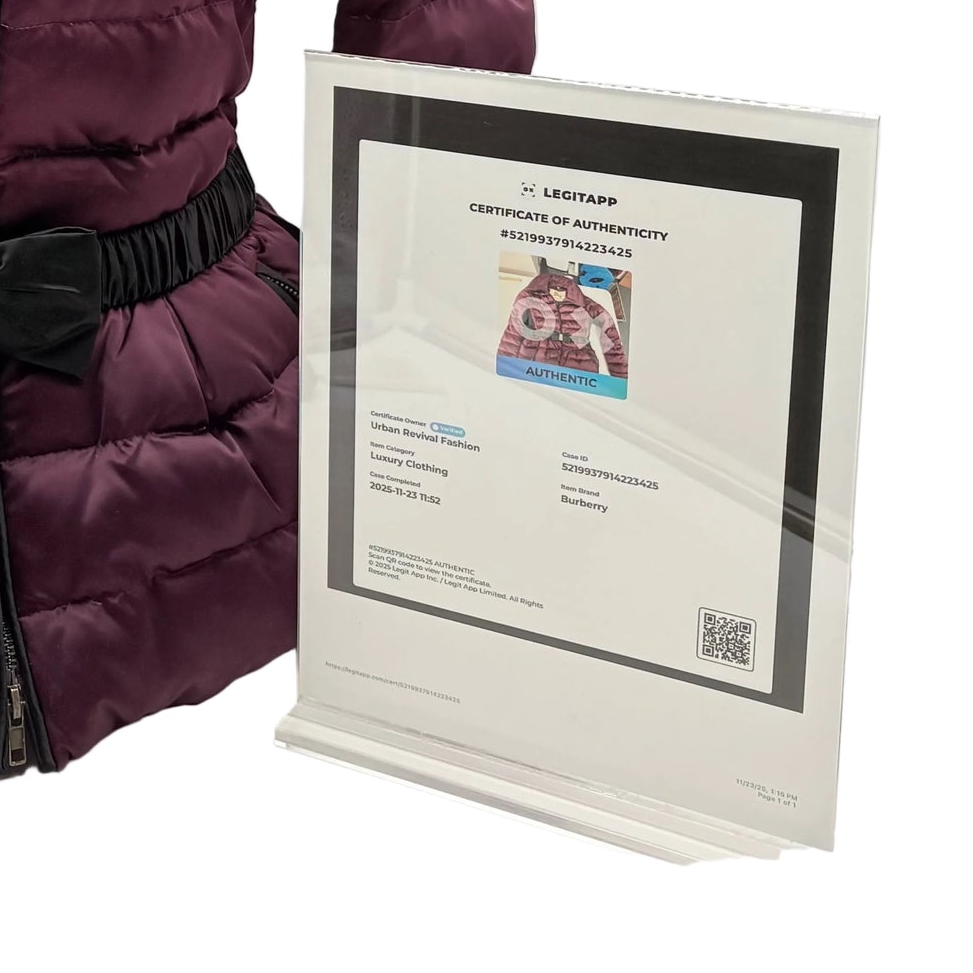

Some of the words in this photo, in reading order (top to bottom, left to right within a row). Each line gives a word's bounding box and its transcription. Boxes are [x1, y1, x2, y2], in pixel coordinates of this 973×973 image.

[543, 187, 618, 207] LEGITAPP
[469, 203, 549, 223] CERTIFICATE
[552, 215, 570, 226] OF
[573, 218, 669, 241] AUTHENTICITY
[500, 229, 633, 258] #5219937914223425
[526, 366, 597, 388] AUTHENTIC
[371, 411, 403, 423] Certificate
[405, 419, 427, 427] Owner
[371, 421, 401, 435] Urban
[403, 429, 438, 443] Revival
[441, 437, 481, 452] Fashion
[370, 441, 385, 449] Item
[386, 444, 415, 457] Category
[562, 451, 579, 460] Case
[371, 452, 403, 467] Luxury
[406, 459, 449, 477] Clothing
[370, 471, 385, 479] Case
[386, 475, 421, 487] Completed
[561, 463, 659, 490] 5219937914223425
[370, 481, 417, 499] 2025-11-23
[420, 493, 441, 505] 11:52
[561, 484, 577, 493] Item
[579, 488, 599, 497] Brand
[561, 495, 608, 513] Burberry
[368, 552, 385, 560] Scan
[386, 556, 396, 564] QR
[398, 559, 415, 568] code
[425, 566, 440, 575] view
[442, 570, 454, 578] the
[455, 573, 491, 588] certificate.
[368, 567, 400, 580] Reserved.
[434, 561, 475, 575] AUTHENTIC
[375, 561, 391, 570] 2025
[392, 565, 409, 575] Legit
[411, 570, 425, 579] App
[427, 574, 439, 583] Inc.
[445, 578, 462, 589] Legit
[463, 583, 478, 592] App
[480, 587, 508, 600] Limited.
[520, 598, 544, 609] Rights
[758, 792, 775, 802] Page
[787, 793, 797, 801] PM
